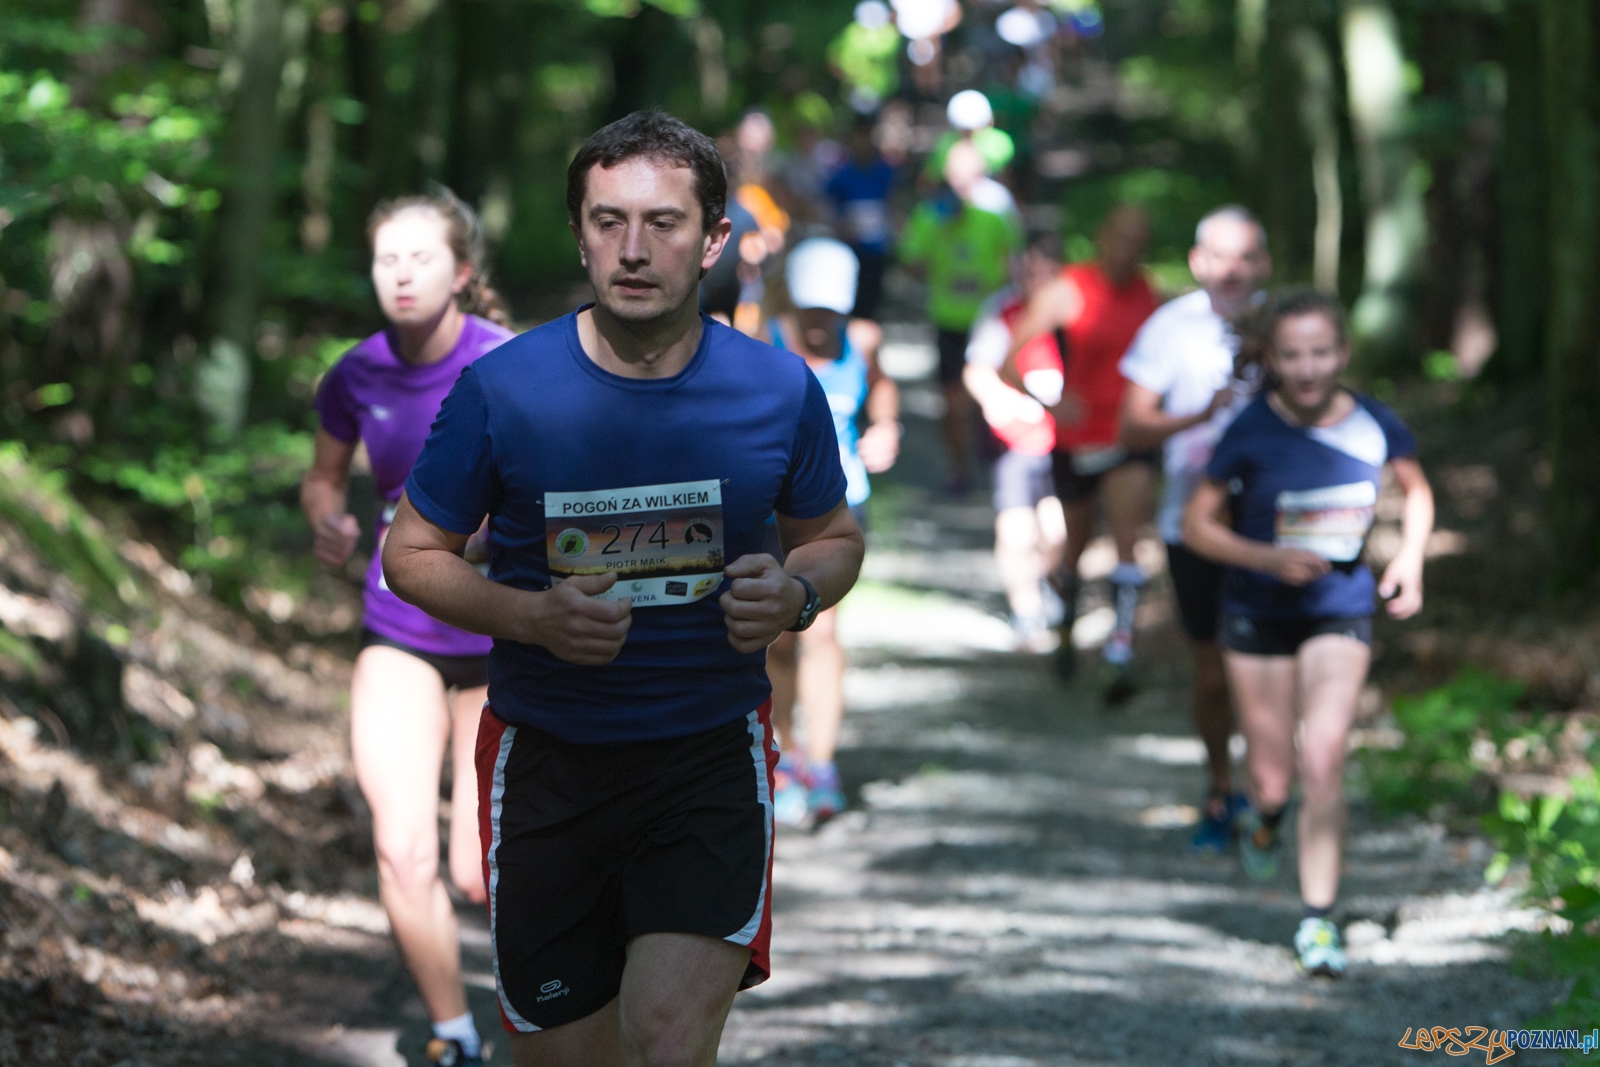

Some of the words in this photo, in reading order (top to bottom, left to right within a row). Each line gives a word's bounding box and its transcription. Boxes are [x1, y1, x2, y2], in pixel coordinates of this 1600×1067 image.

[563, 497, 617, 514] POGOŃ
[622, 497, 642, 511] ZA
[645, 491, 709, 509] WILKIEM
[601, 520, 670, 555] 274
[606, 560, 637, 569] PIOTR
[640, 556, 667, 567] MAIK
